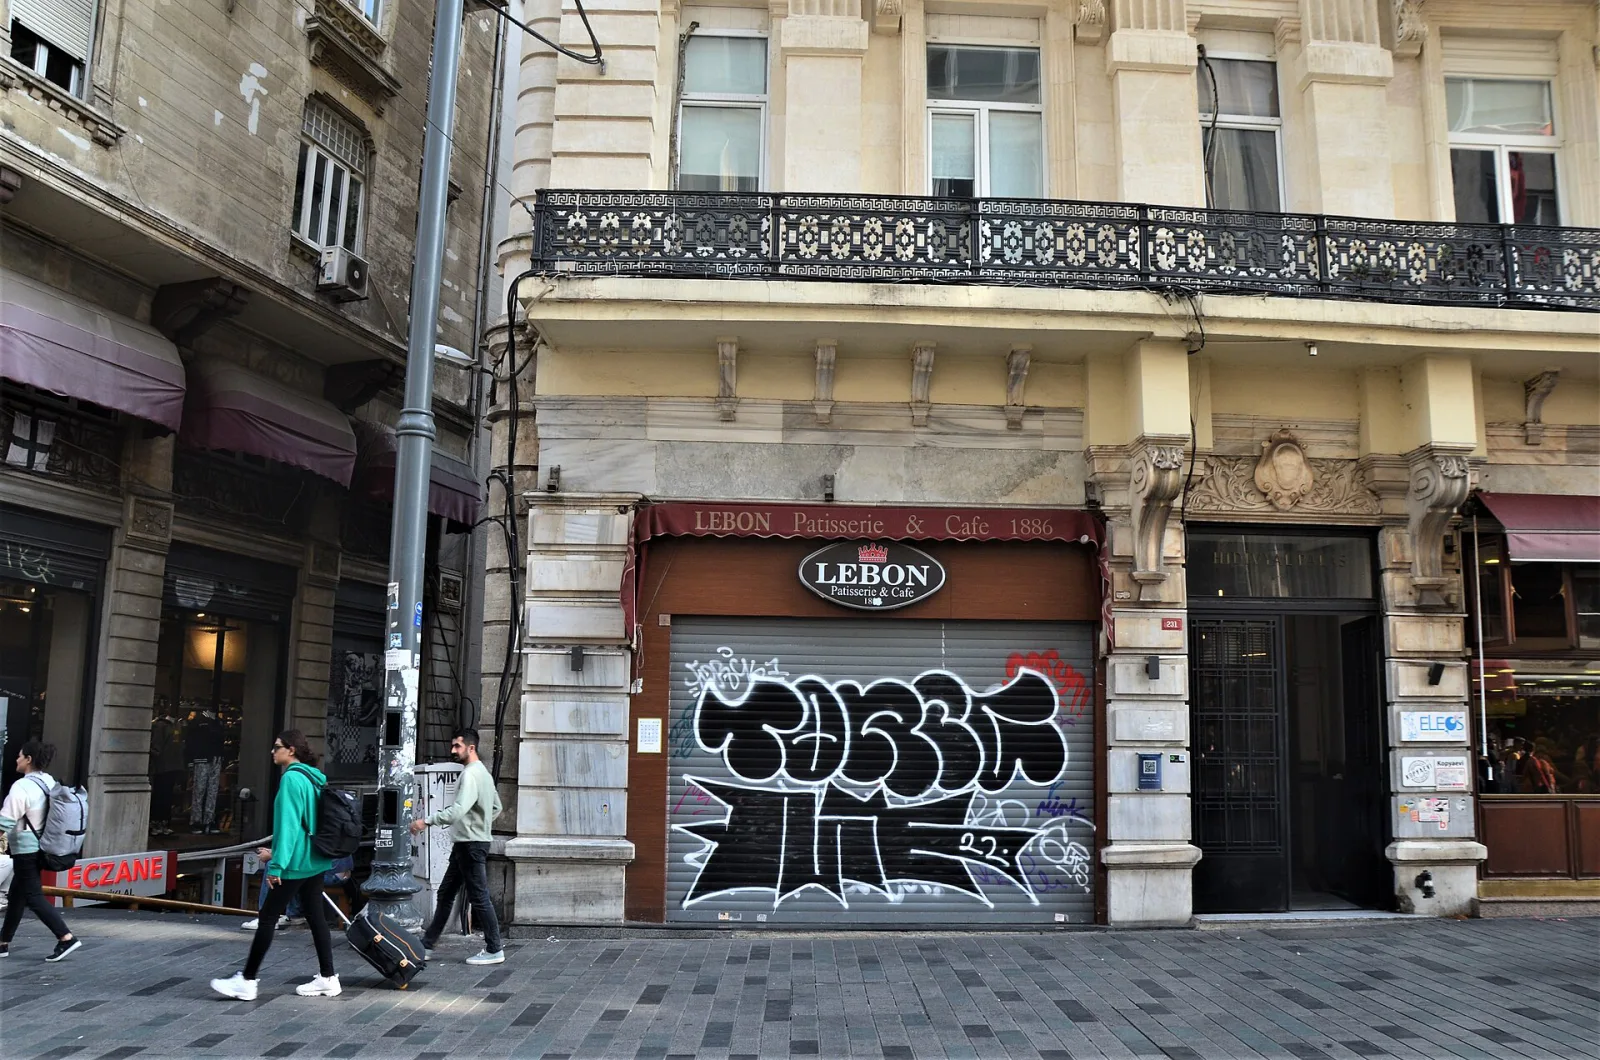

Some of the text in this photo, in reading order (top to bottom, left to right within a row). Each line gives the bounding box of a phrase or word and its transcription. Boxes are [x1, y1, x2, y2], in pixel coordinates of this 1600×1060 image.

[694, 511, 1053, 536] LEBON Patisserie & Cafe 1886
[815, 562, 930, 587] LEBON
[830, 585, 914, 598] Patisserie & Cafe
[864, 597, 883, 606] 18
[1166, 620, 1178, 628] 231
[1419, 715, 1465, 732] ELEOS
[67, 856, 163, 890] ECZANE
